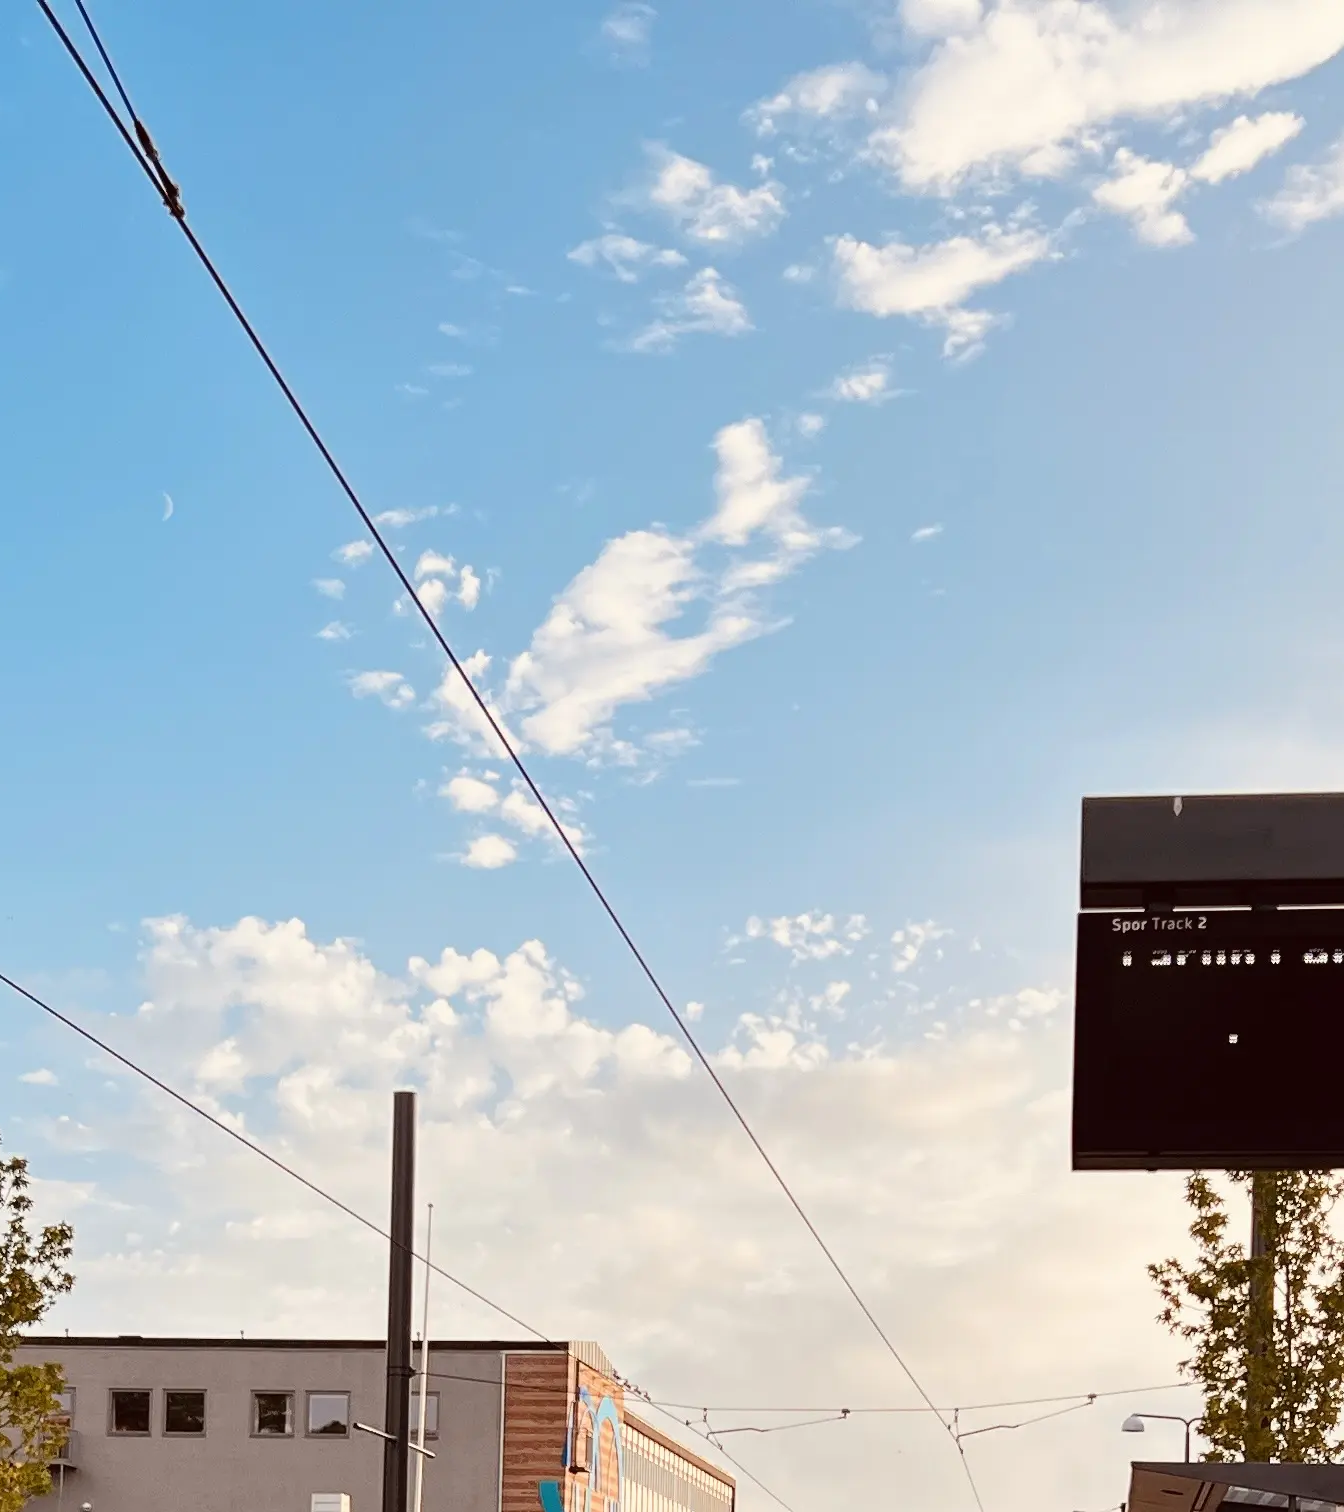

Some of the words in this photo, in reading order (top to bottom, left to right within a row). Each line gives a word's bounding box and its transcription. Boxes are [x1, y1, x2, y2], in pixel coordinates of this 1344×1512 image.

[1111, 917, 1147, 933] Spor
[1152, 917, 1192, 930] Track
[1197, 916, 1207, 929] 2
